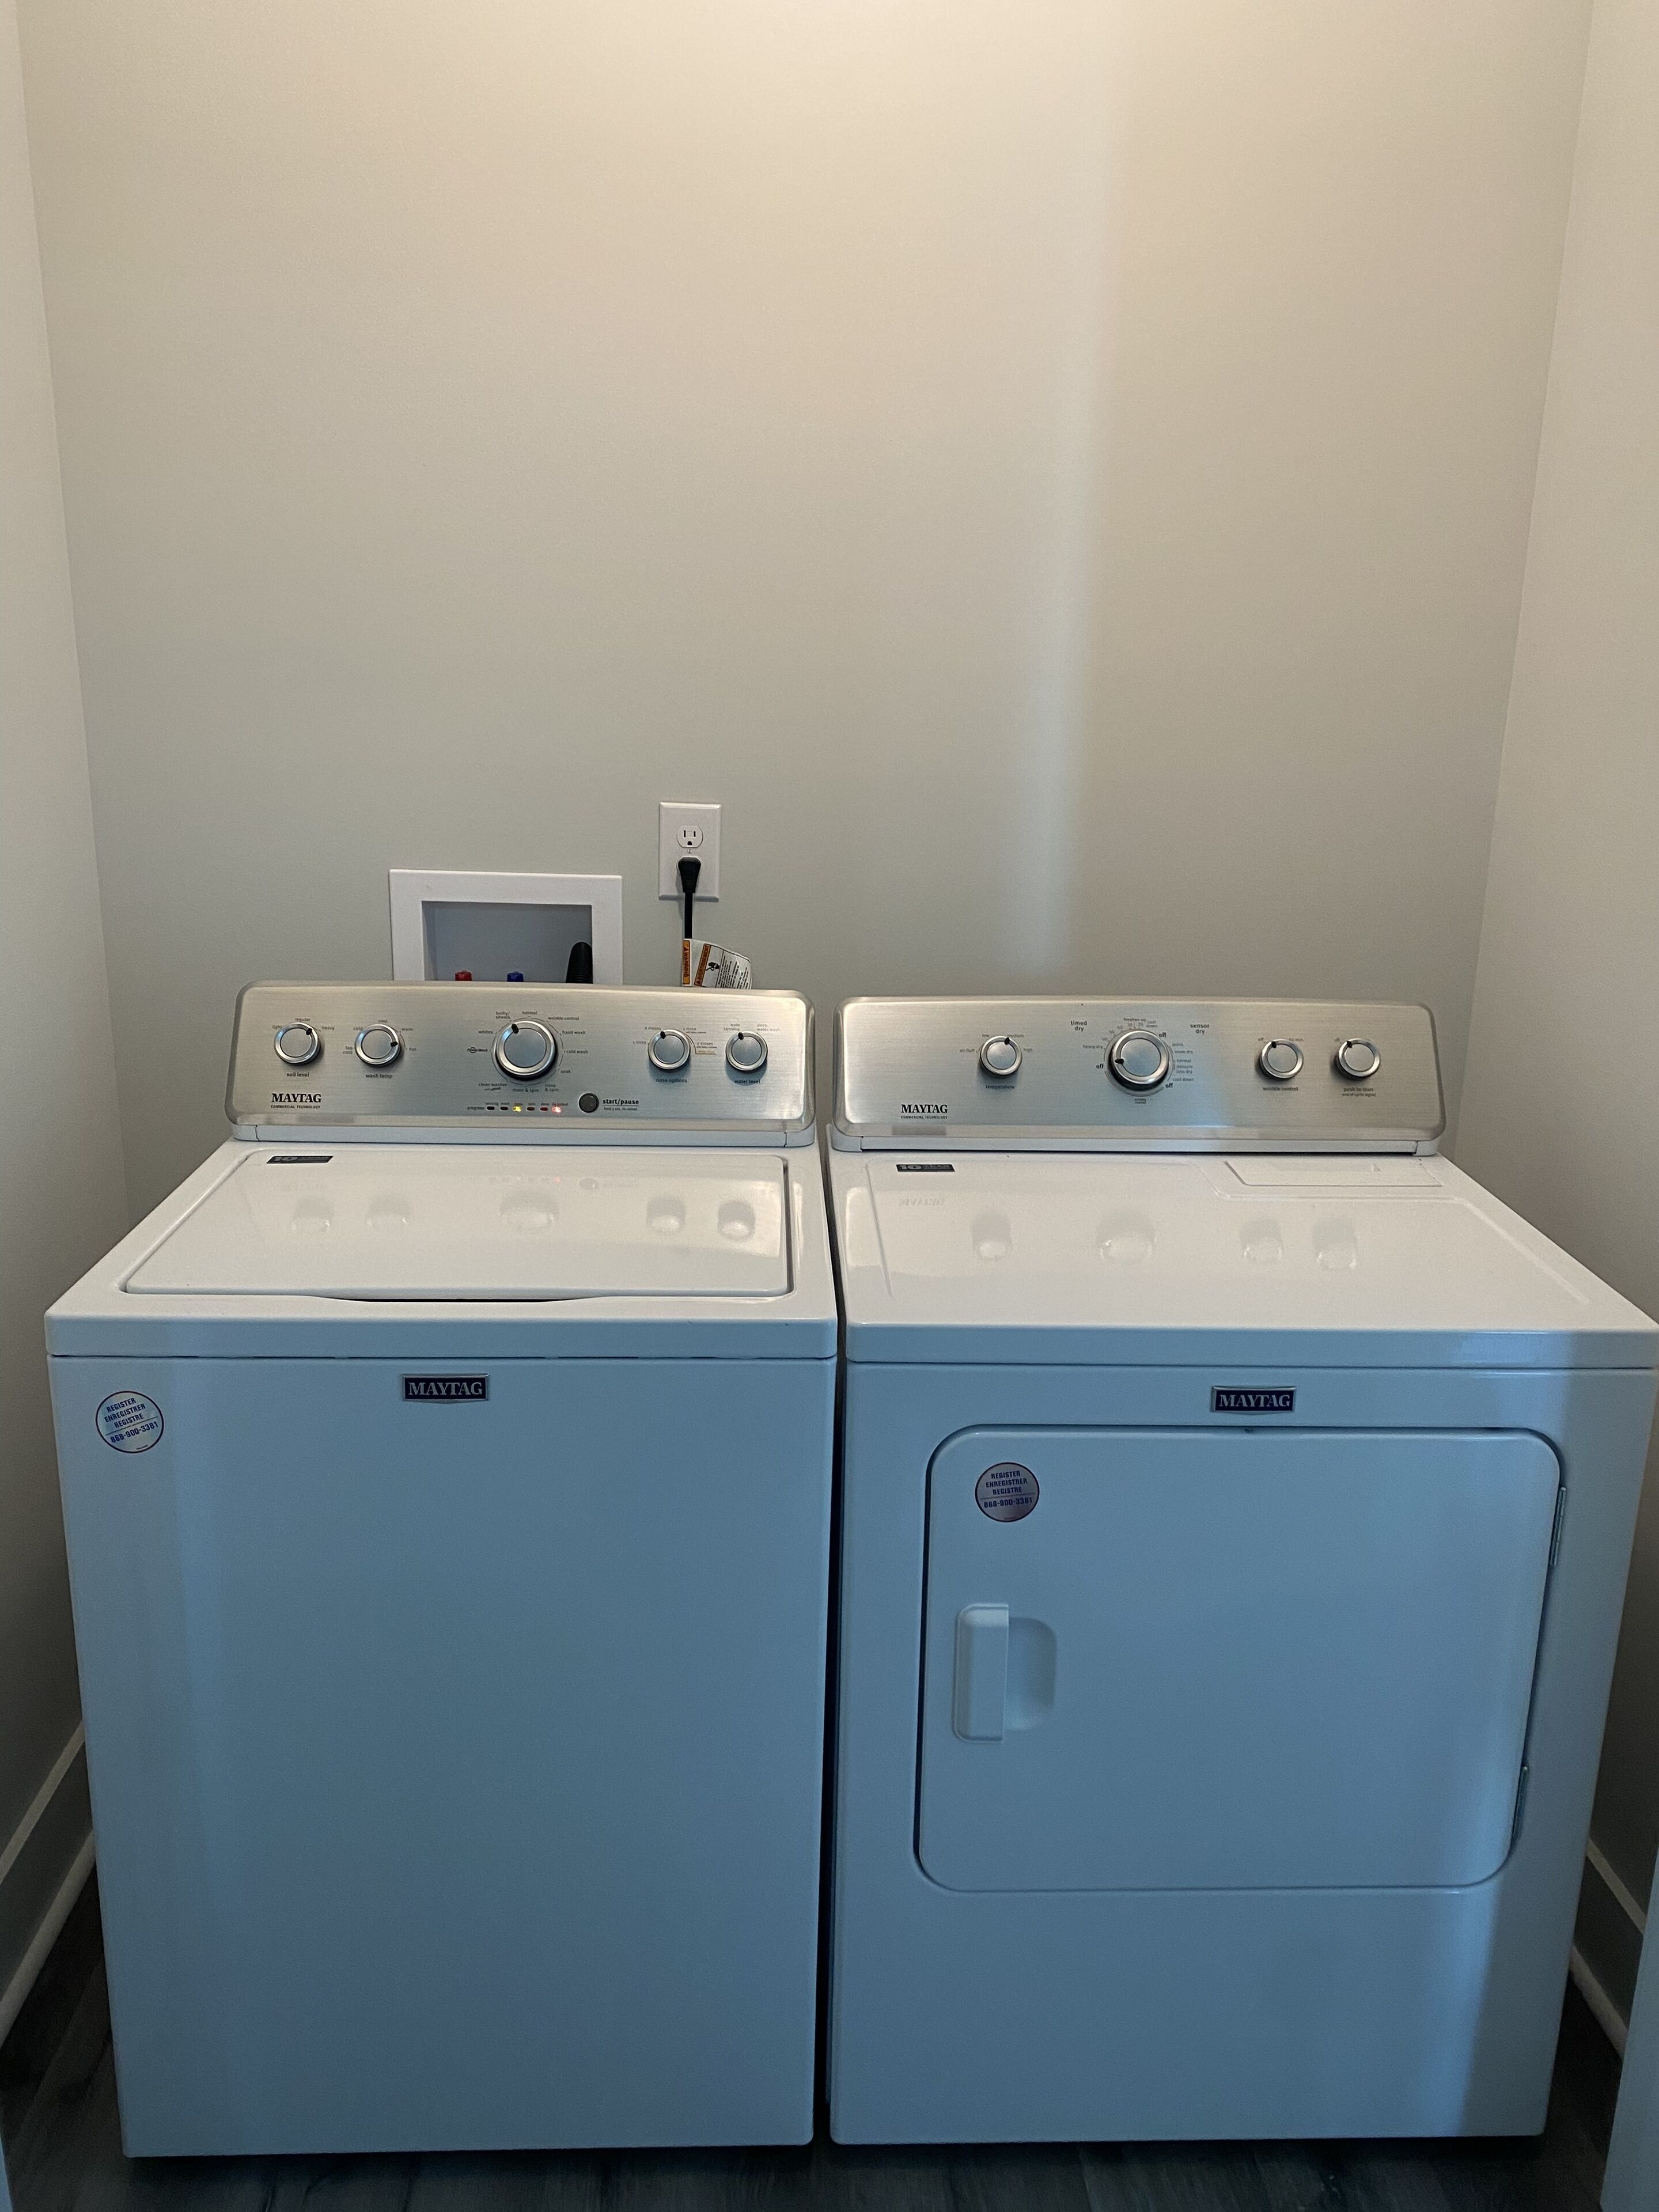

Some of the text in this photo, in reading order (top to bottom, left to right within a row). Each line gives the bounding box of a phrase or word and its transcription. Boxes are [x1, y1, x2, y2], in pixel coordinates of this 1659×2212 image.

[271, 1093, 322, 1103] MAYTAG
[901, 1104, 948, 1113] MAYTAG
[408, 1382, 483, 1395] MAYTAG
[106, 1397, 137, 1412] REGISTER
[1219, 1394, 1290, 1407] MAYTAG
[104, 1403, 146, 1422] ENREGISTRER
[114, 1413, 144, 1429] REGISTRE
[991, 1470, 1021, 1480] REGISTER
[986, 1478, 1028, 1488] ENREGISTRER
[993, 1486, 1022, 1495] REGISTRE
